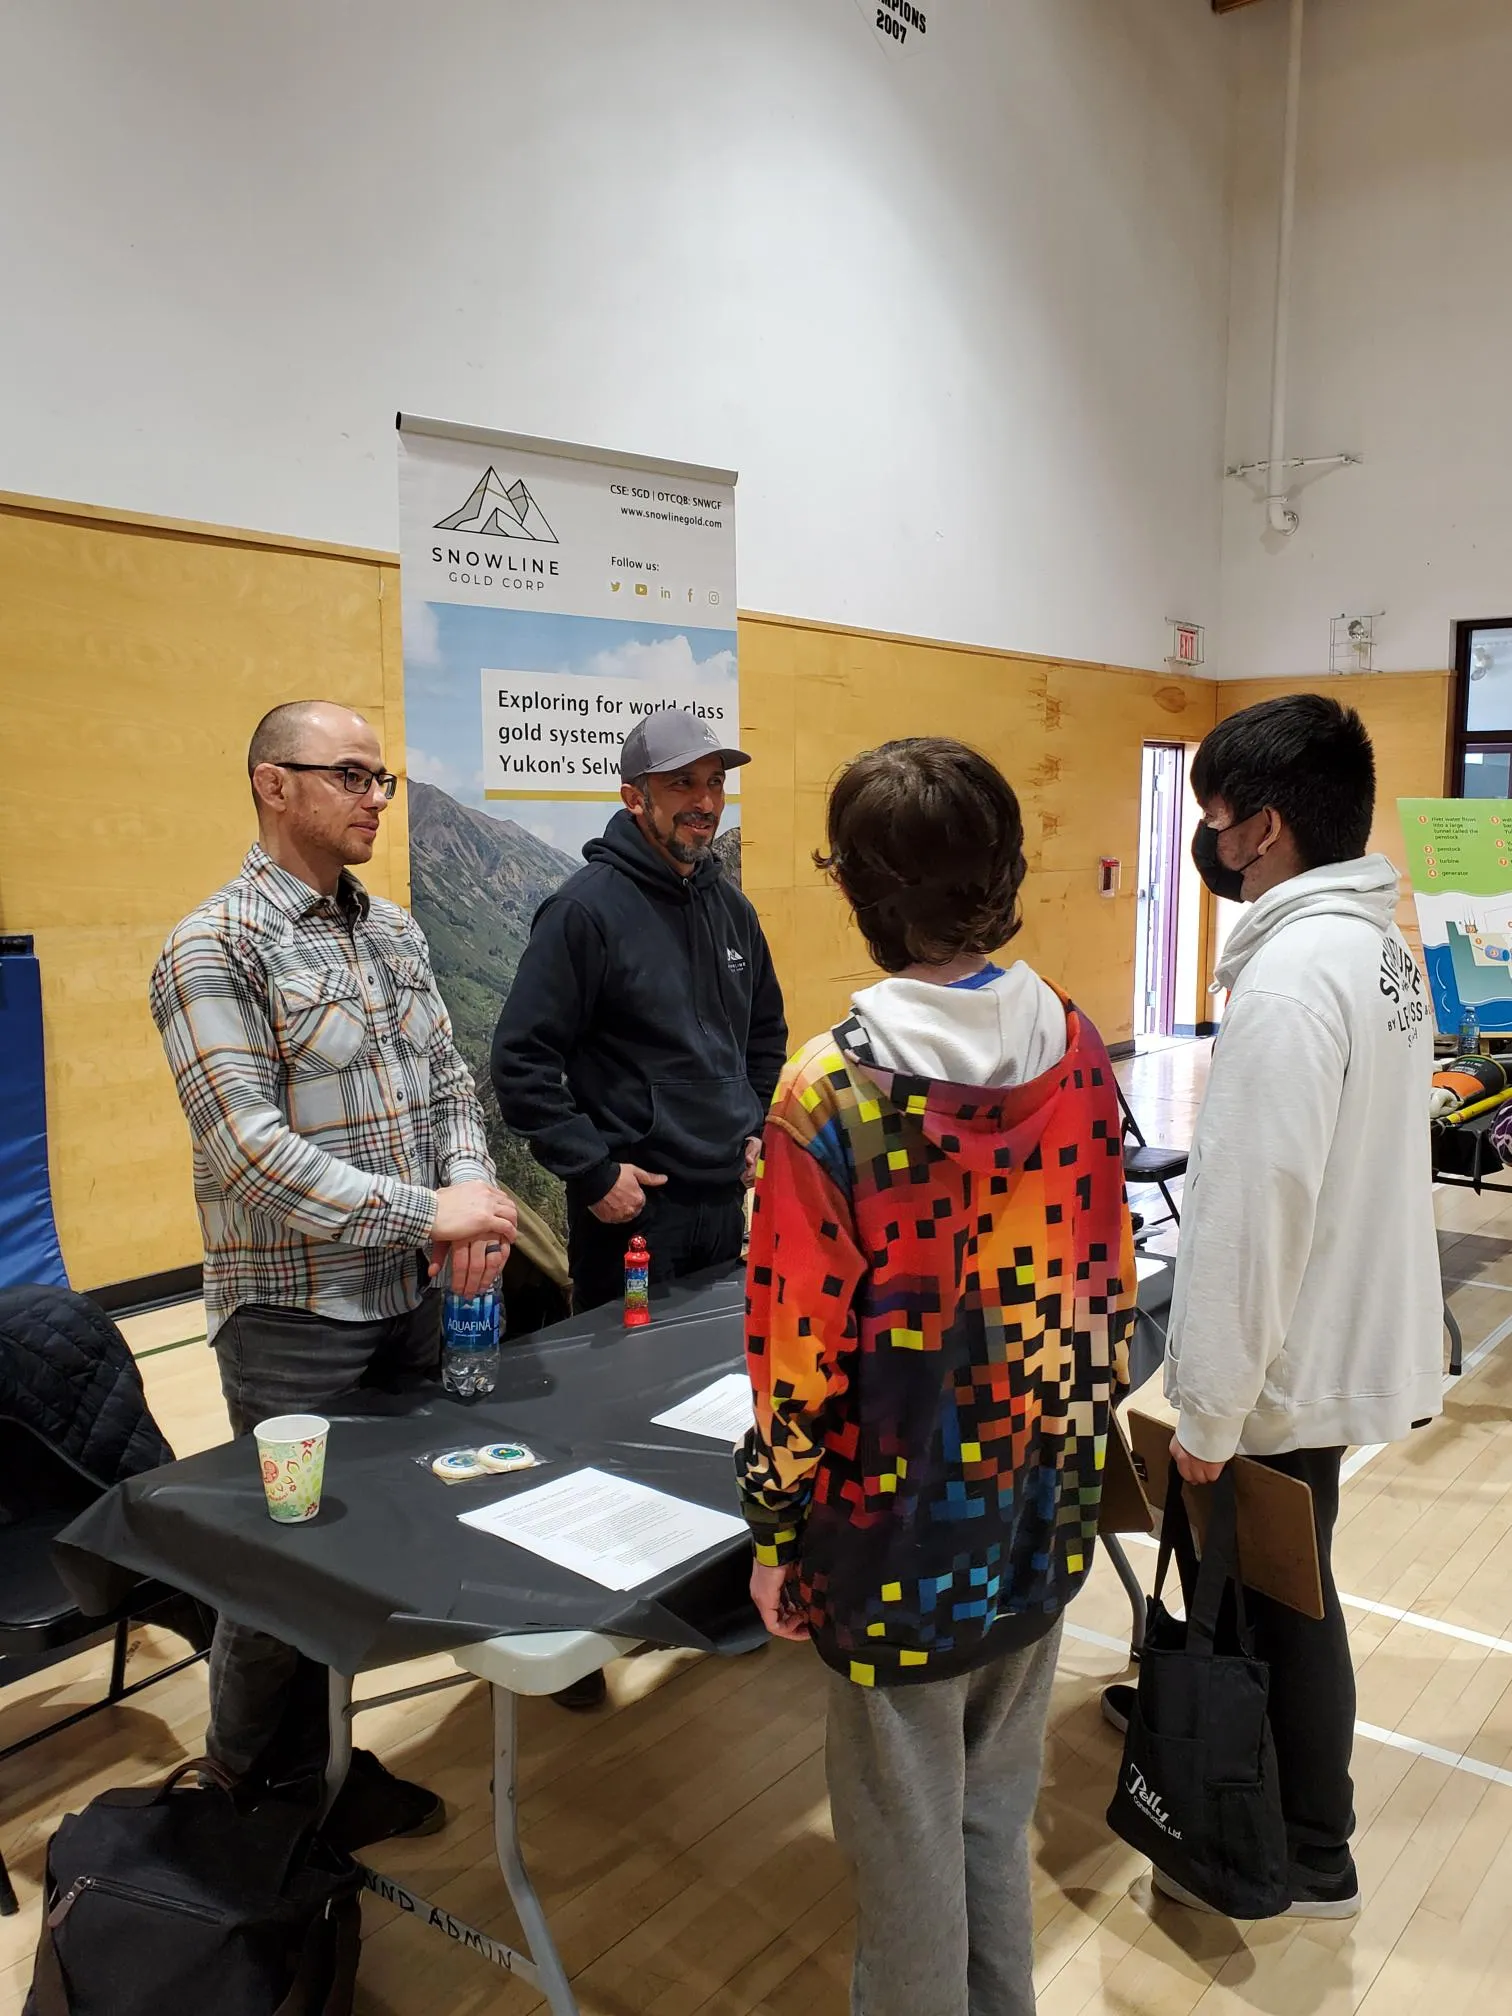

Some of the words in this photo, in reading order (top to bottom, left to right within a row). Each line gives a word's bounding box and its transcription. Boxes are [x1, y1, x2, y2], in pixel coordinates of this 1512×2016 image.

[876, 9, 907, 44] 2007
[610, 484, 629, 496] CSE:
[631, 488, 650, 499] SGD
[657, 492, 691, 505] OTCQB:
[692, 497, 723, 510] SNWGF
[621, 507, 723, 528] www.snowlinegold.com
[432, 547, 560, 576] SNOWLINE
[611, 556, 643, 569] Follow
[646, 562, 660, 572] us:
[449, 572, 493, 586] GOLD
[502, 577, 544, 591] CORP
[498, 690, 589, 716] Exploring
[596, 695, 623, 714] for
[498, 722, 542, 744] gold
[549, 726, 625, 746] systems
[499, 754, 575, 774] Yukon's
[447, 1318, 491, 1333] AQUAFINA
[1126, 1763, 1170, 1823] Pelly
[1167, 1826, 1183, 1840] Ltd.
[428, 1907, 513, 1970] ADMIN
